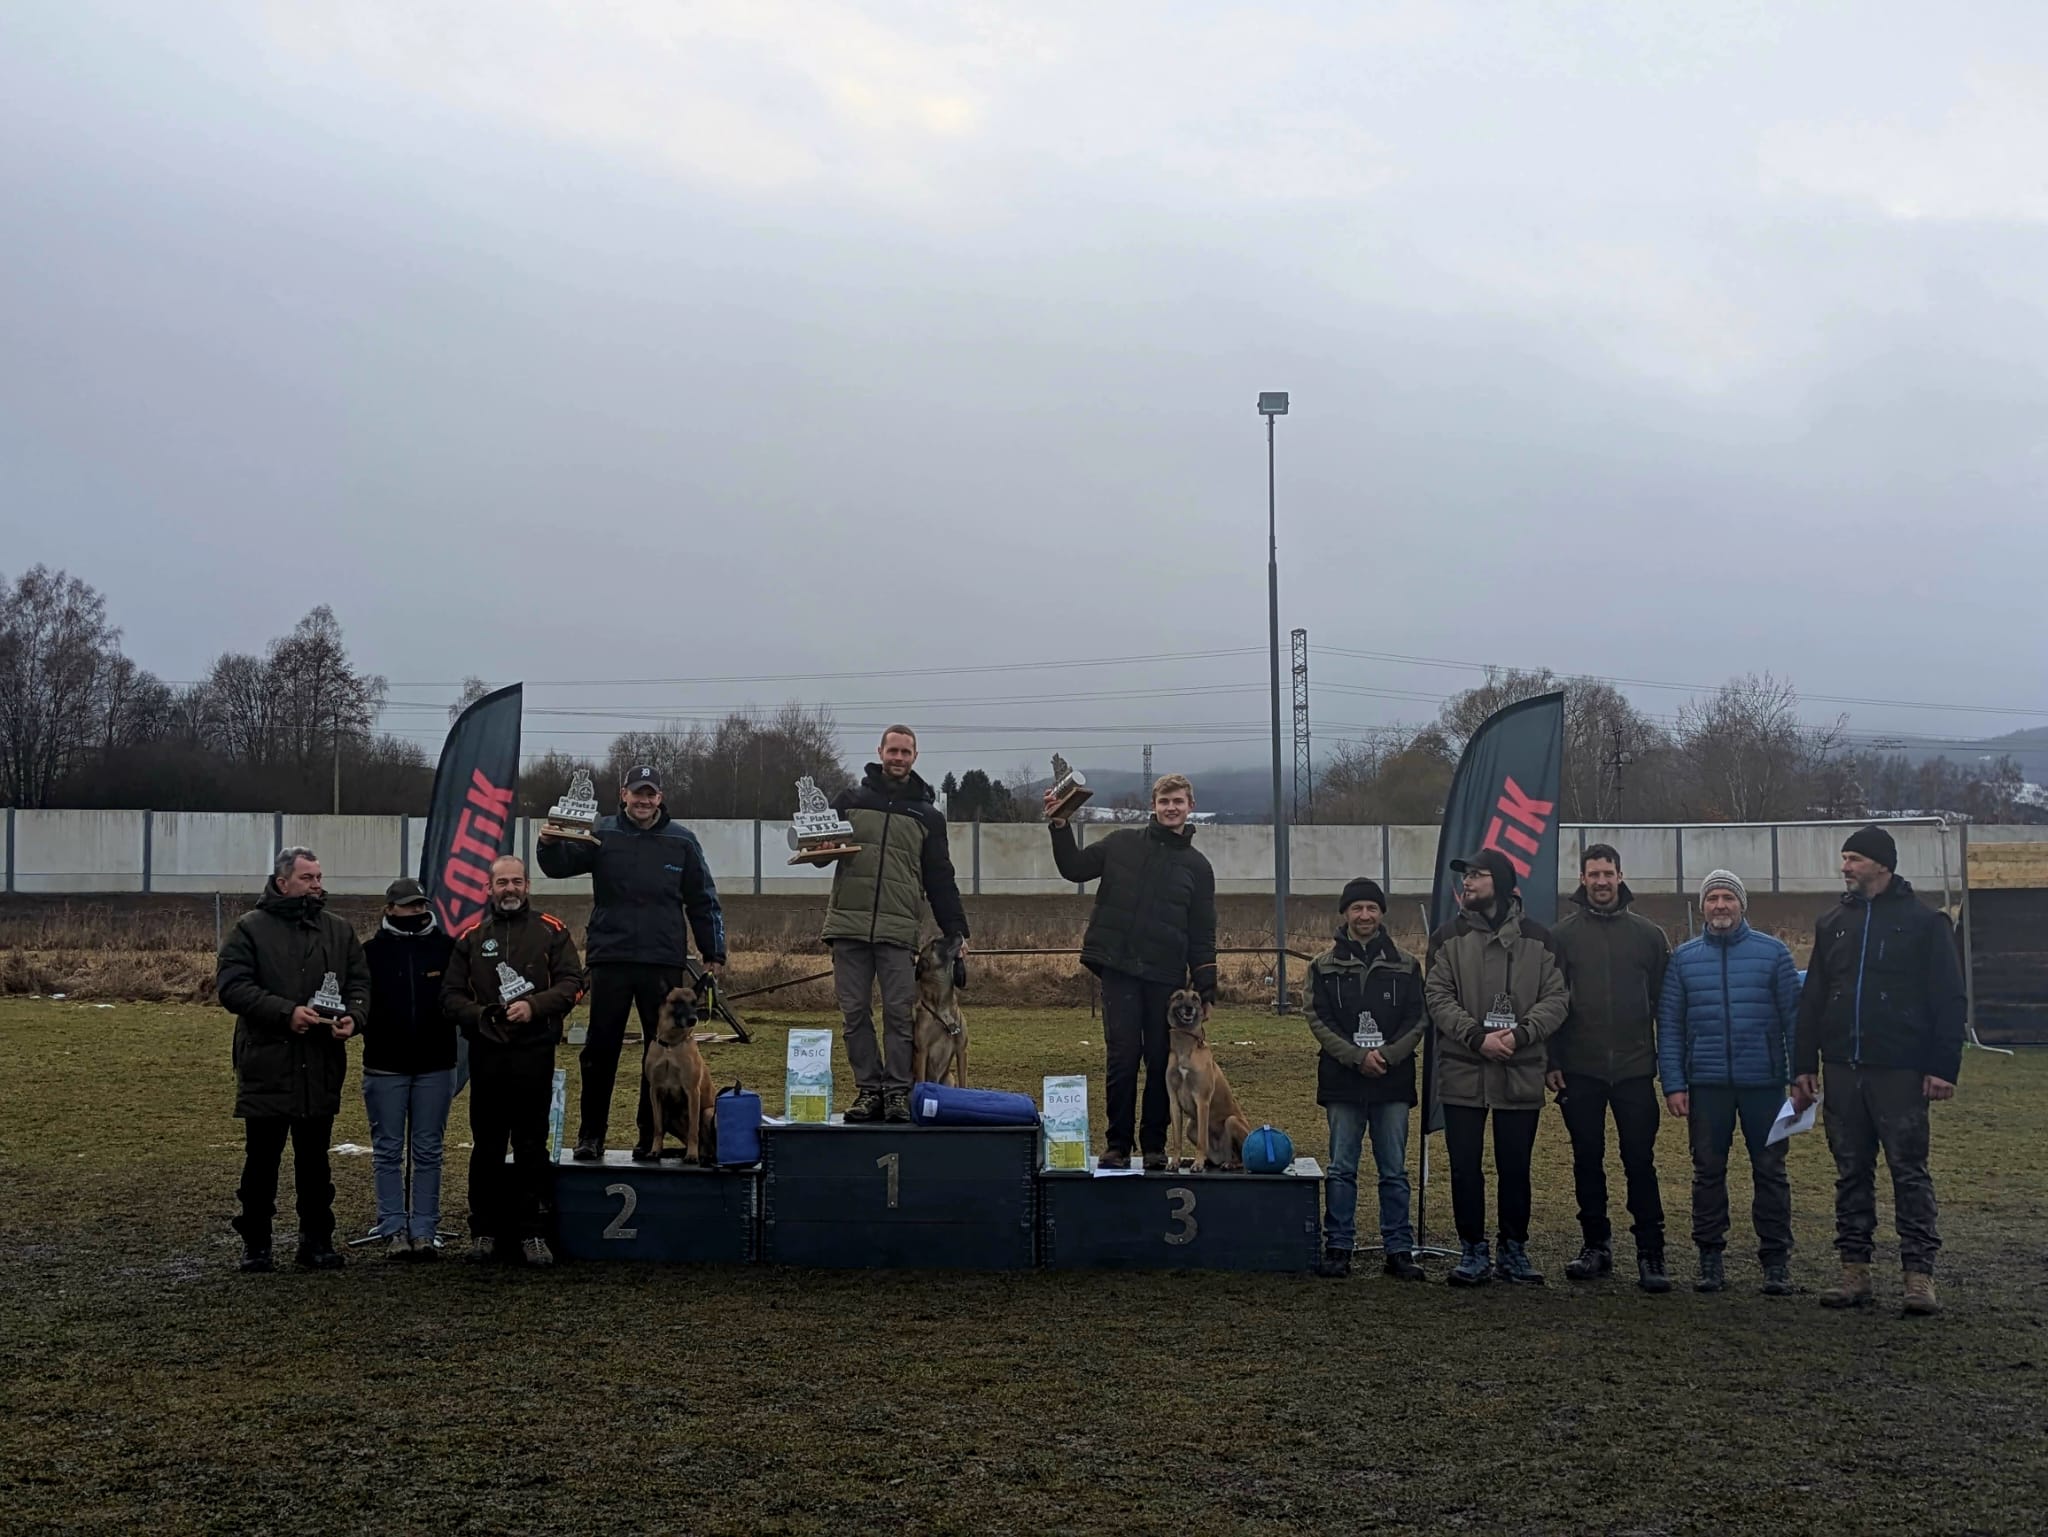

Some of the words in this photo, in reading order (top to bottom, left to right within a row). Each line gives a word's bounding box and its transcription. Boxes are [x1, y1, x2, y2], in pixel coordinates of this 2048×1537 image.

[793, 1048, 826, 1057] BASIC
[1049, 1095, 1081, 1104] BASIC
[876, 1152, 899, 1208] 1
[603, 1183, 638, 1239] 2
[1164, 1187, 1198, 1245] 3
